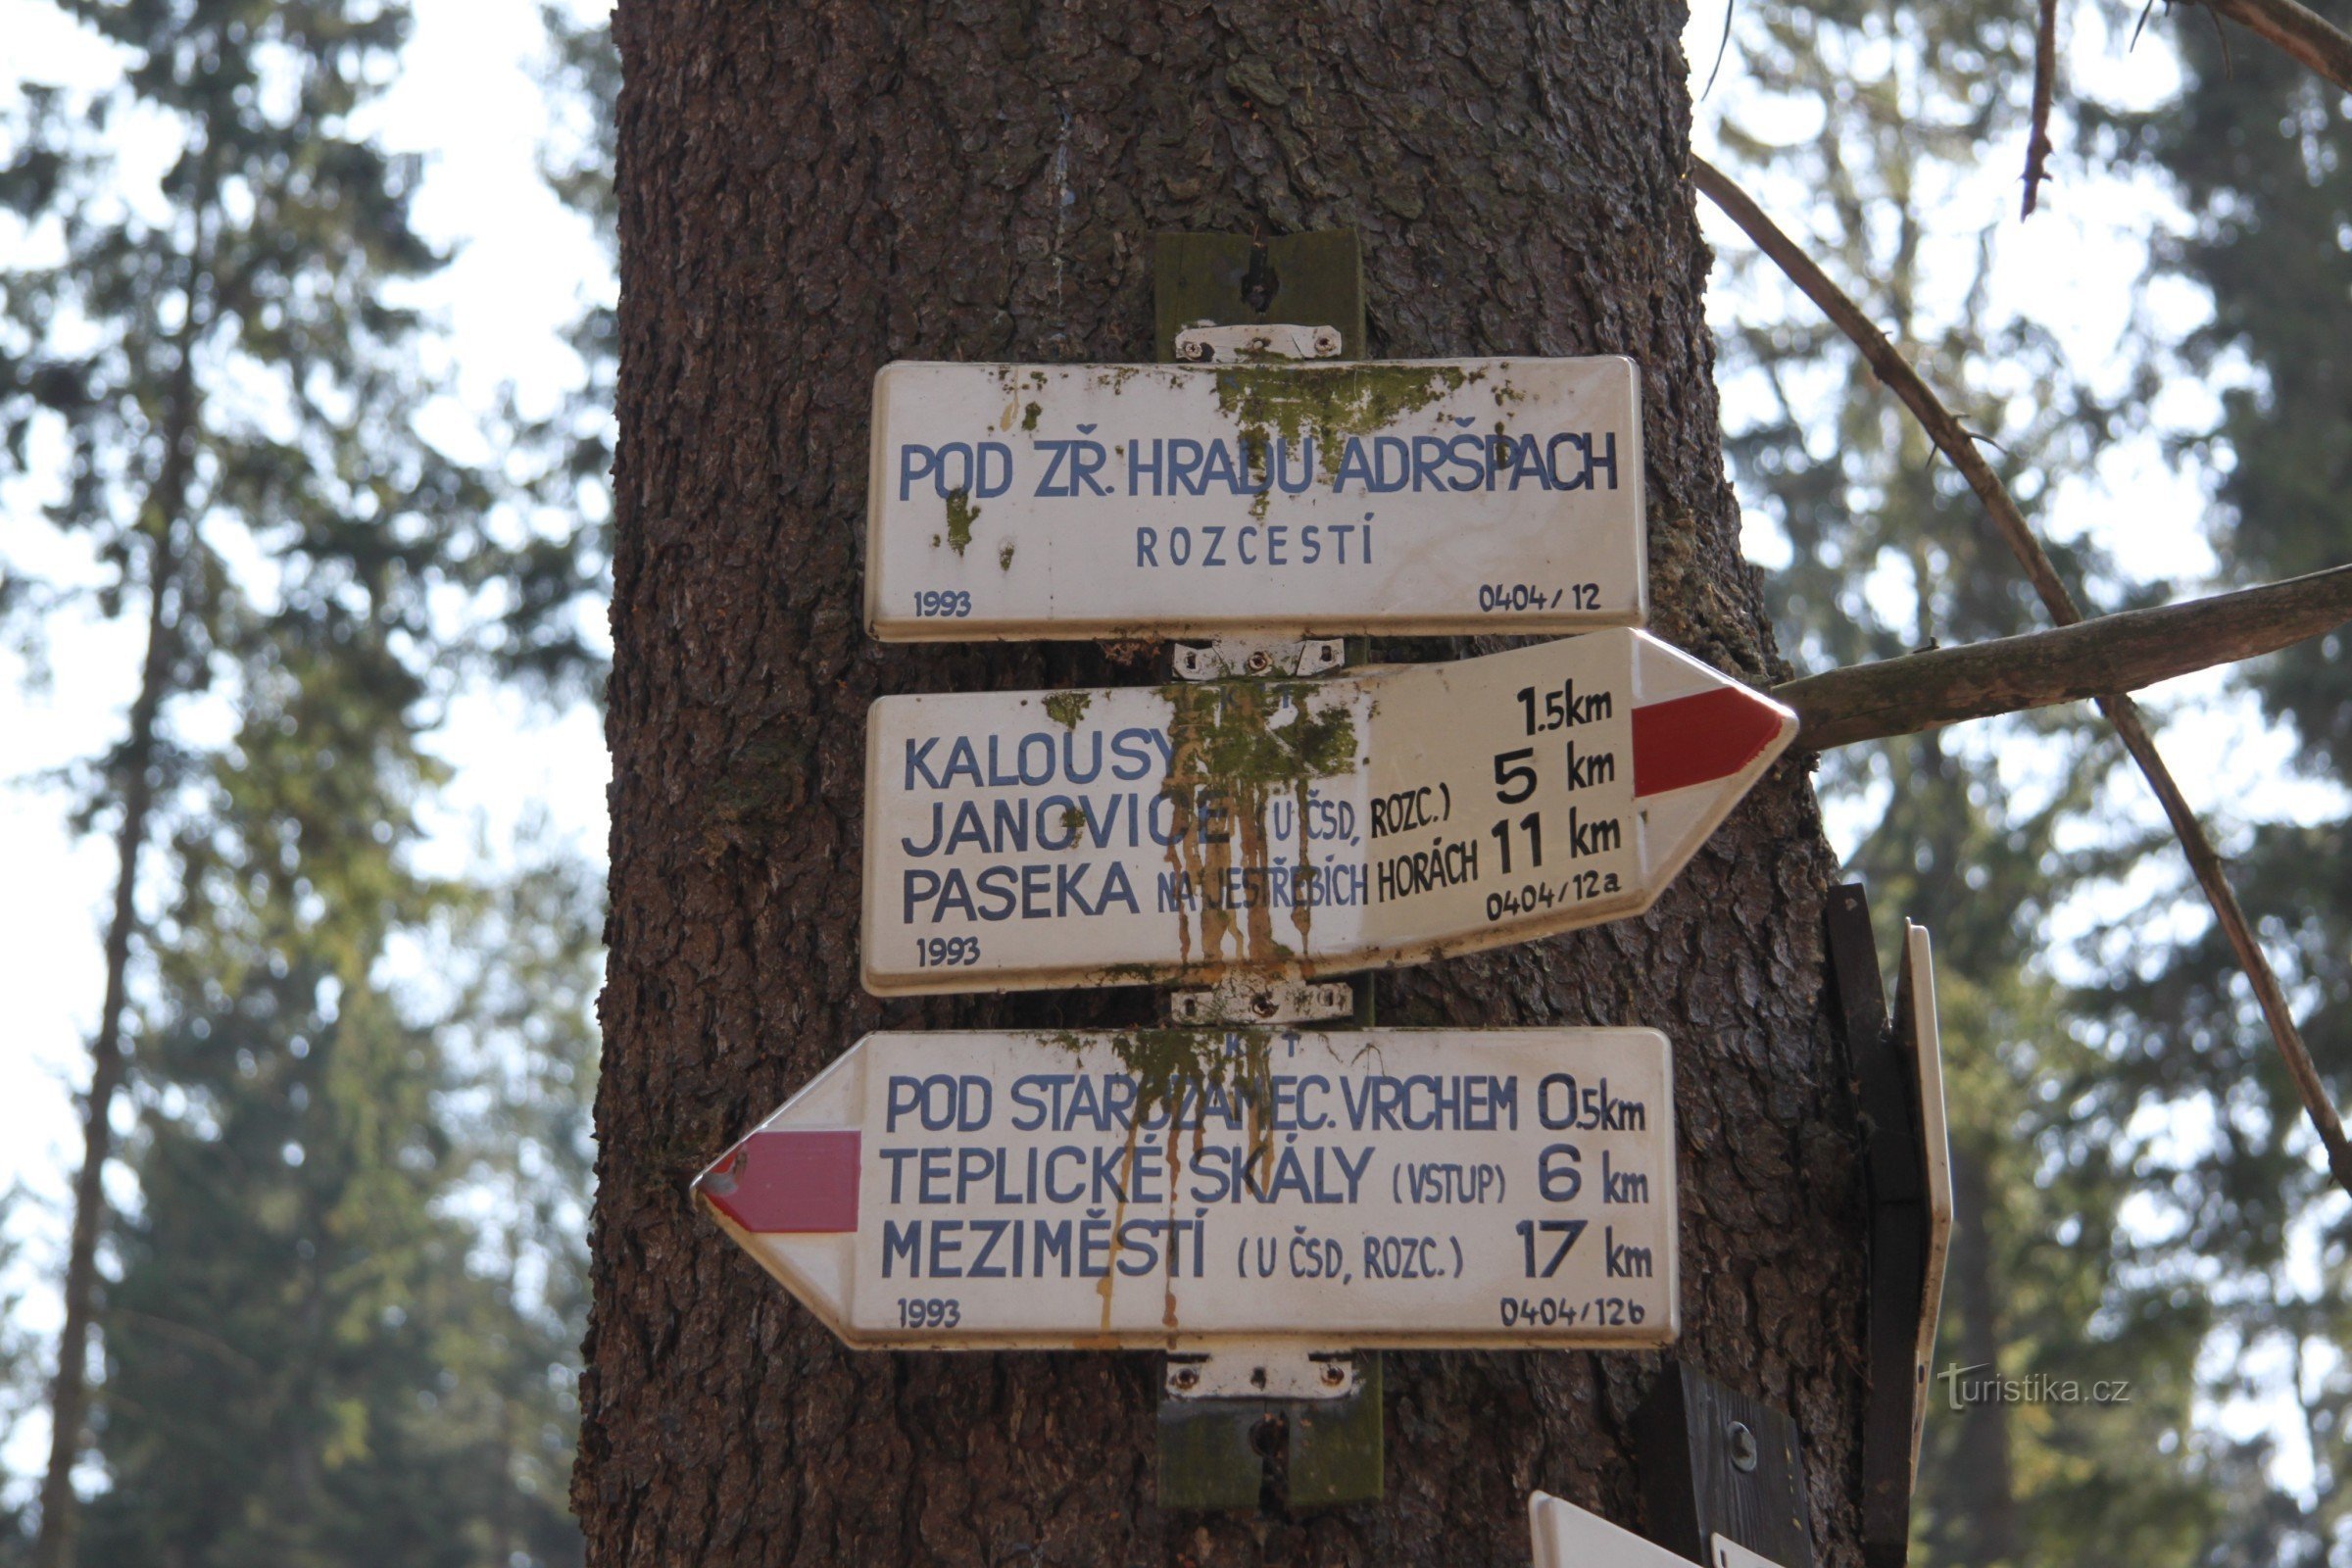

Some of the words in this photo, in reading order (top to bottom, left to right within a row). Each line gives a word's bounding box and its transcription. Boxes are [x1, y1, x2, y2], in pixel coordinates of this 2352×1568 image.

[901, 442, 1012, 502] POD
[1034, 423, 1115, 497] ZŘ.
[1129, 437, 1313, 496] HRADU
[1333, 416, 1617, 493] ADRŠPACH
[1137, 512, 1373, 566] ROZCESTÍ
[913, 591, 971, 617] 1993
[904, 727, 1179, 790] KALOUSY
[902, 789, 1230, 858] JANOVICE
[1307, 789, 1360, 847] ČSD,
[1370, 782, 1451, 839] ROZC.)
[1494, 747, 1538, 805] 5
[1567, 740, 1615, 792] km
[903, 861, 1140, 925] PASEKA
[1157, 870, 1197, 912] NA
[1201, 854, 1368, 909] JESTŘEBÍCH
[1378, 836, 1479, 902] HORÁCH
[1491, 811, 1542, 874] 11
[1569, 807, 1621, 859] km
[917, 937, 981, 967] 1993
[887, 1074, 993, 1133] POD
[880, 1133, 1163, 1205] TEPLICKÉ
[1190, 1132, 1376, 1205] SKÁLY
[1393, 1163, 1505, 1205] (VSTUP)
[1539, 1143, 1582, 1202] 6
[1602, 1150, 1648, 1203] km
[882, 1208, 1208, 1279] MEZIMĚSTÍ
[1239, 1236, 1275, 1280] (U
[1290, 1225, 1352, 1285] ČSD,
[1365, 1236, 1464, 1280] ROZC.)
[1516, 1219, 1589, 1278] 17
[1605, 1225, 1653, 1278] km
[898, 1298, 960, 1329] 1993
